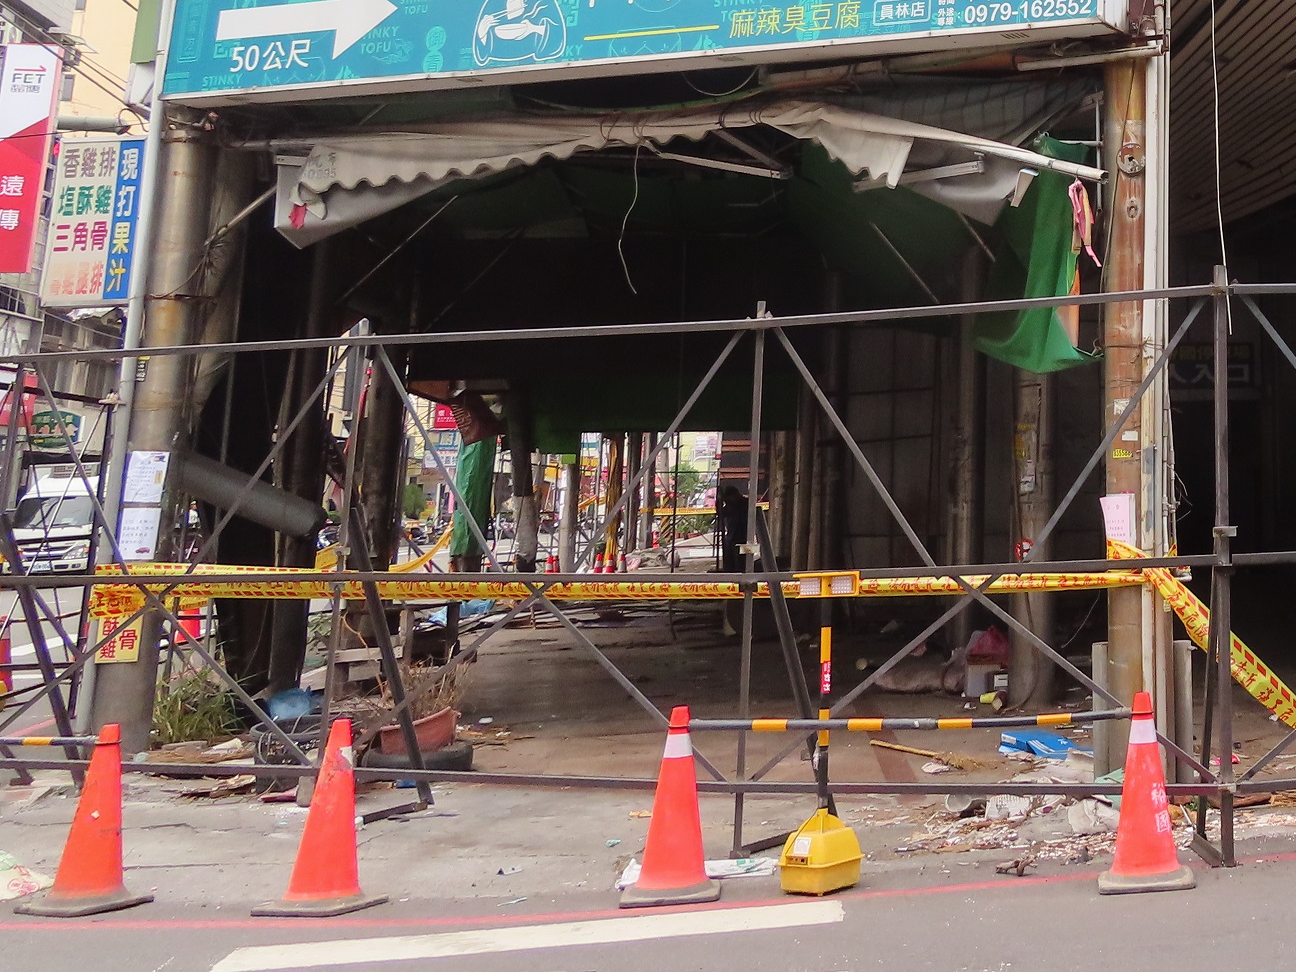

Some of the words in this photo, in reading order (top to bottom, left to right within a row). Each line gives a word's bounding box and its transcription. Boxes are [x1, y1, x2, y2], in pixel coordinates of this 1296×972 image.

[729, 0, 861, 39] 麻辣臭豆腐
[880, 1, 926, 20] 員林店
[229, 39, 311, 74] 50公尺
[360, 41, 392, 55] TOFU
[12, 73, 46, 84] FET
[202, 73, 244, 87] STINKY
[64, 146, 116, 178] 香雞排
[103, 148, 140, 293] 現打果汁
[53, 221, 108, 252] 三角骨
[119, 629, 138, 651] 骨
